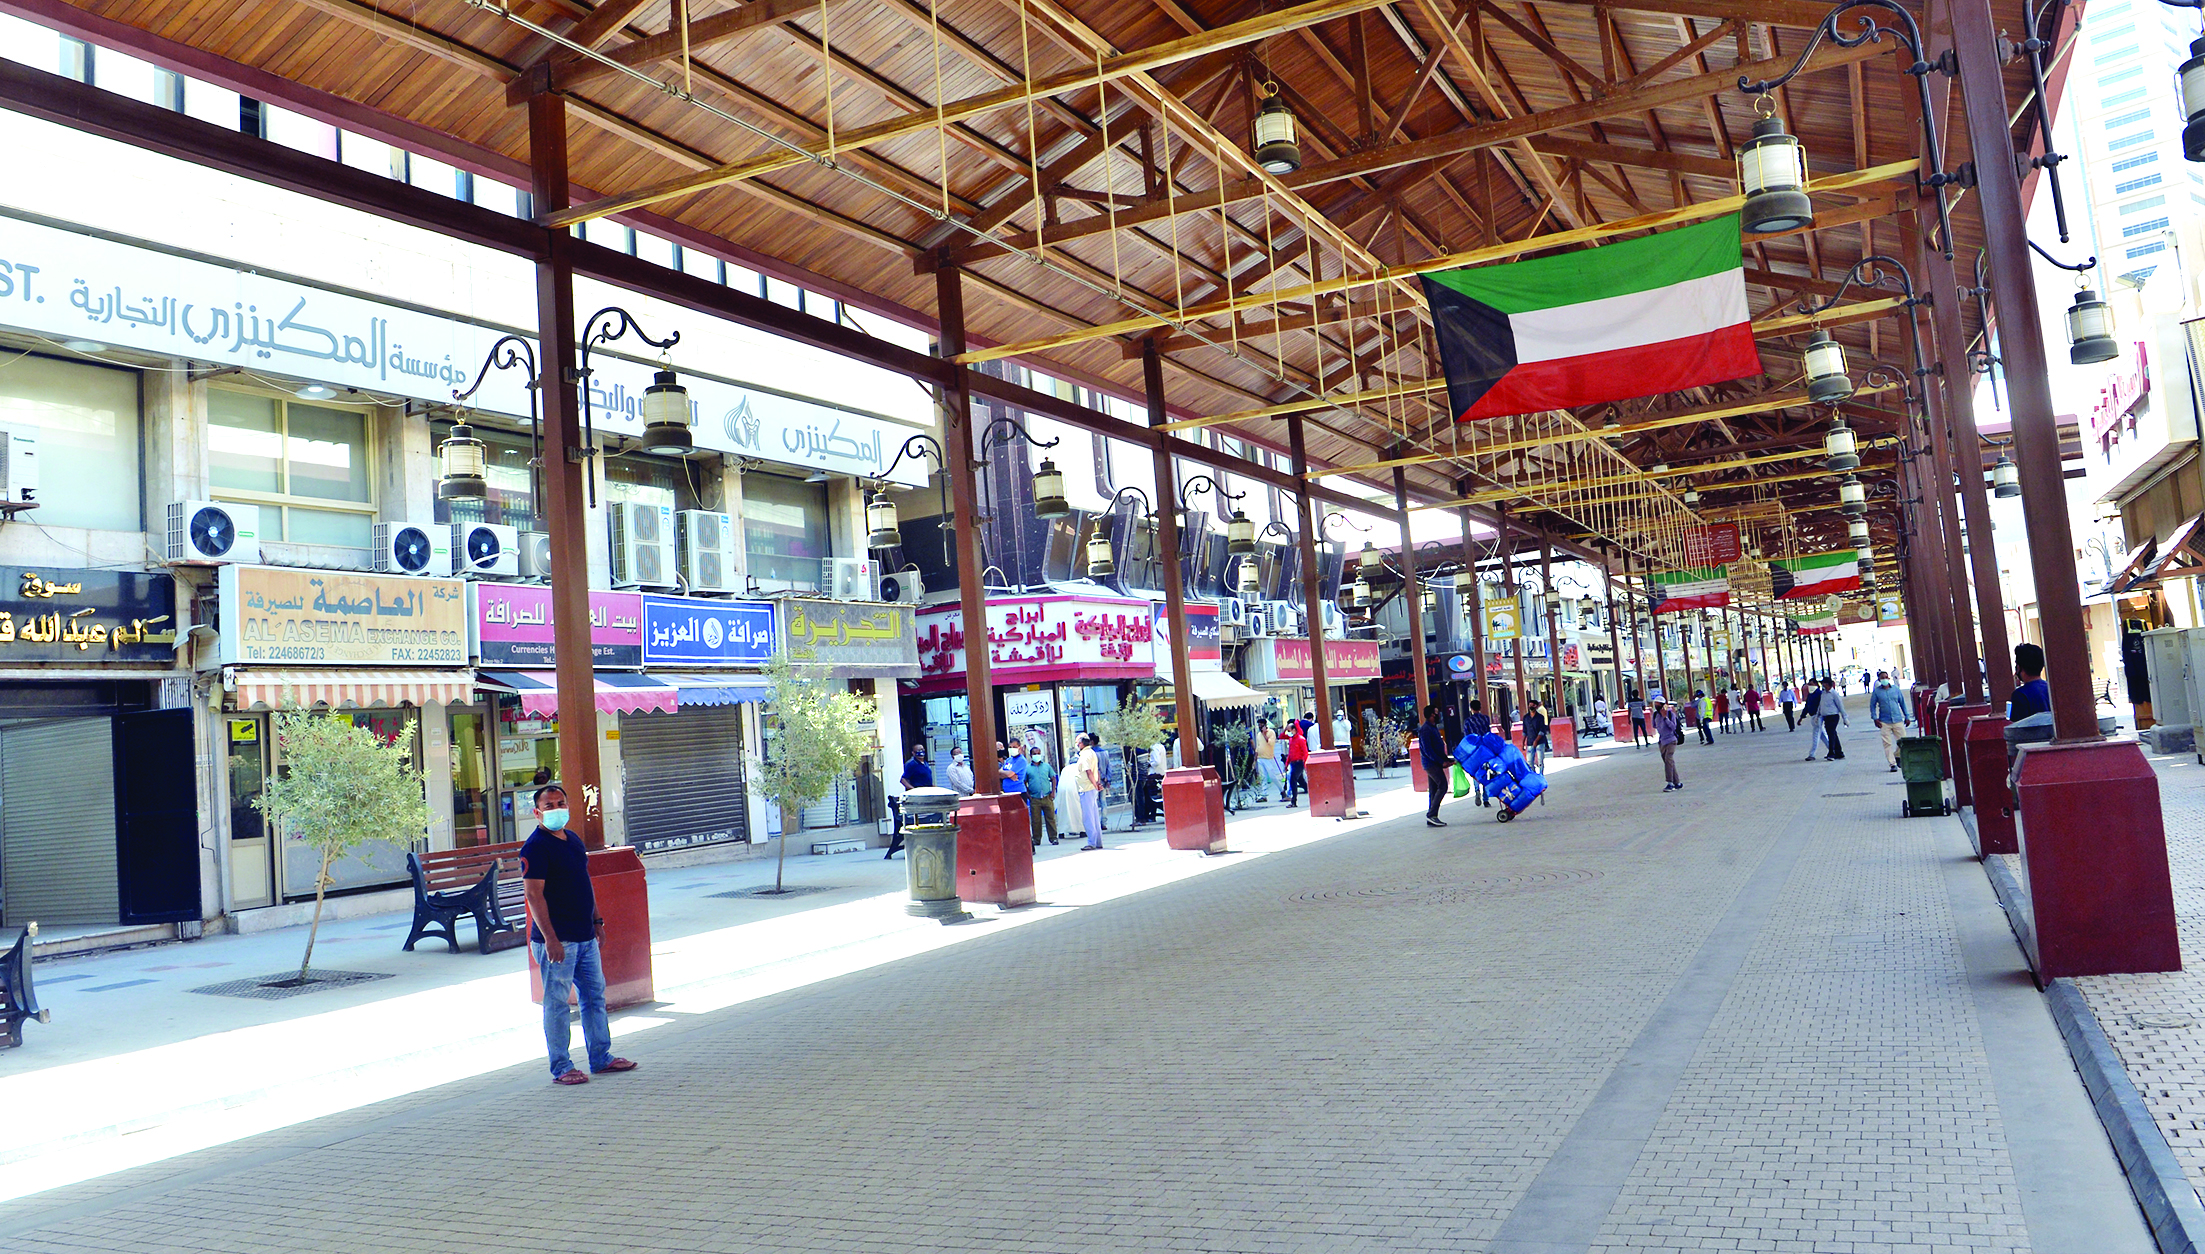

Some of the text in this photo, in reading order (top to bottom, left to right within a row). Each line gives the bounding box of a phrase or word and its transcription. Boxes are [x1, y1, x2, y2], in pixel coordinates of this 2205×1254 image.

[69, 277, 467, 386] مؤسسة المكينزي التجارية
[781, 418, 883, 471] المكينزي
[20, 573, 82, 598] سوق
[432, 586, 460, 602] شركة
[245, 591, 304, 616] للصيرفة
[309, 578, 424, 618] العاصمة
[485, 598, 546, 629] للصرافة
[611, 615, 638, 634] بيت
[1005, 602, 1045, 626] أبراج
[367, 628, 437, 645] EXCHANGE
[440, 630, 461, 646] CO.
[651, 616, 769, 649] صرافة العزيز
[986, 621, 1067, 648] المباركية
[246, 646, 325, 661] Tel: 22468672/3
[391, 648, 461, 662] FAX: 22452823
[511, 644, 548, 654] Currencies
[603, 647, 615, 656] Est.
[991, 643, 1063, 664] للأقمشة
